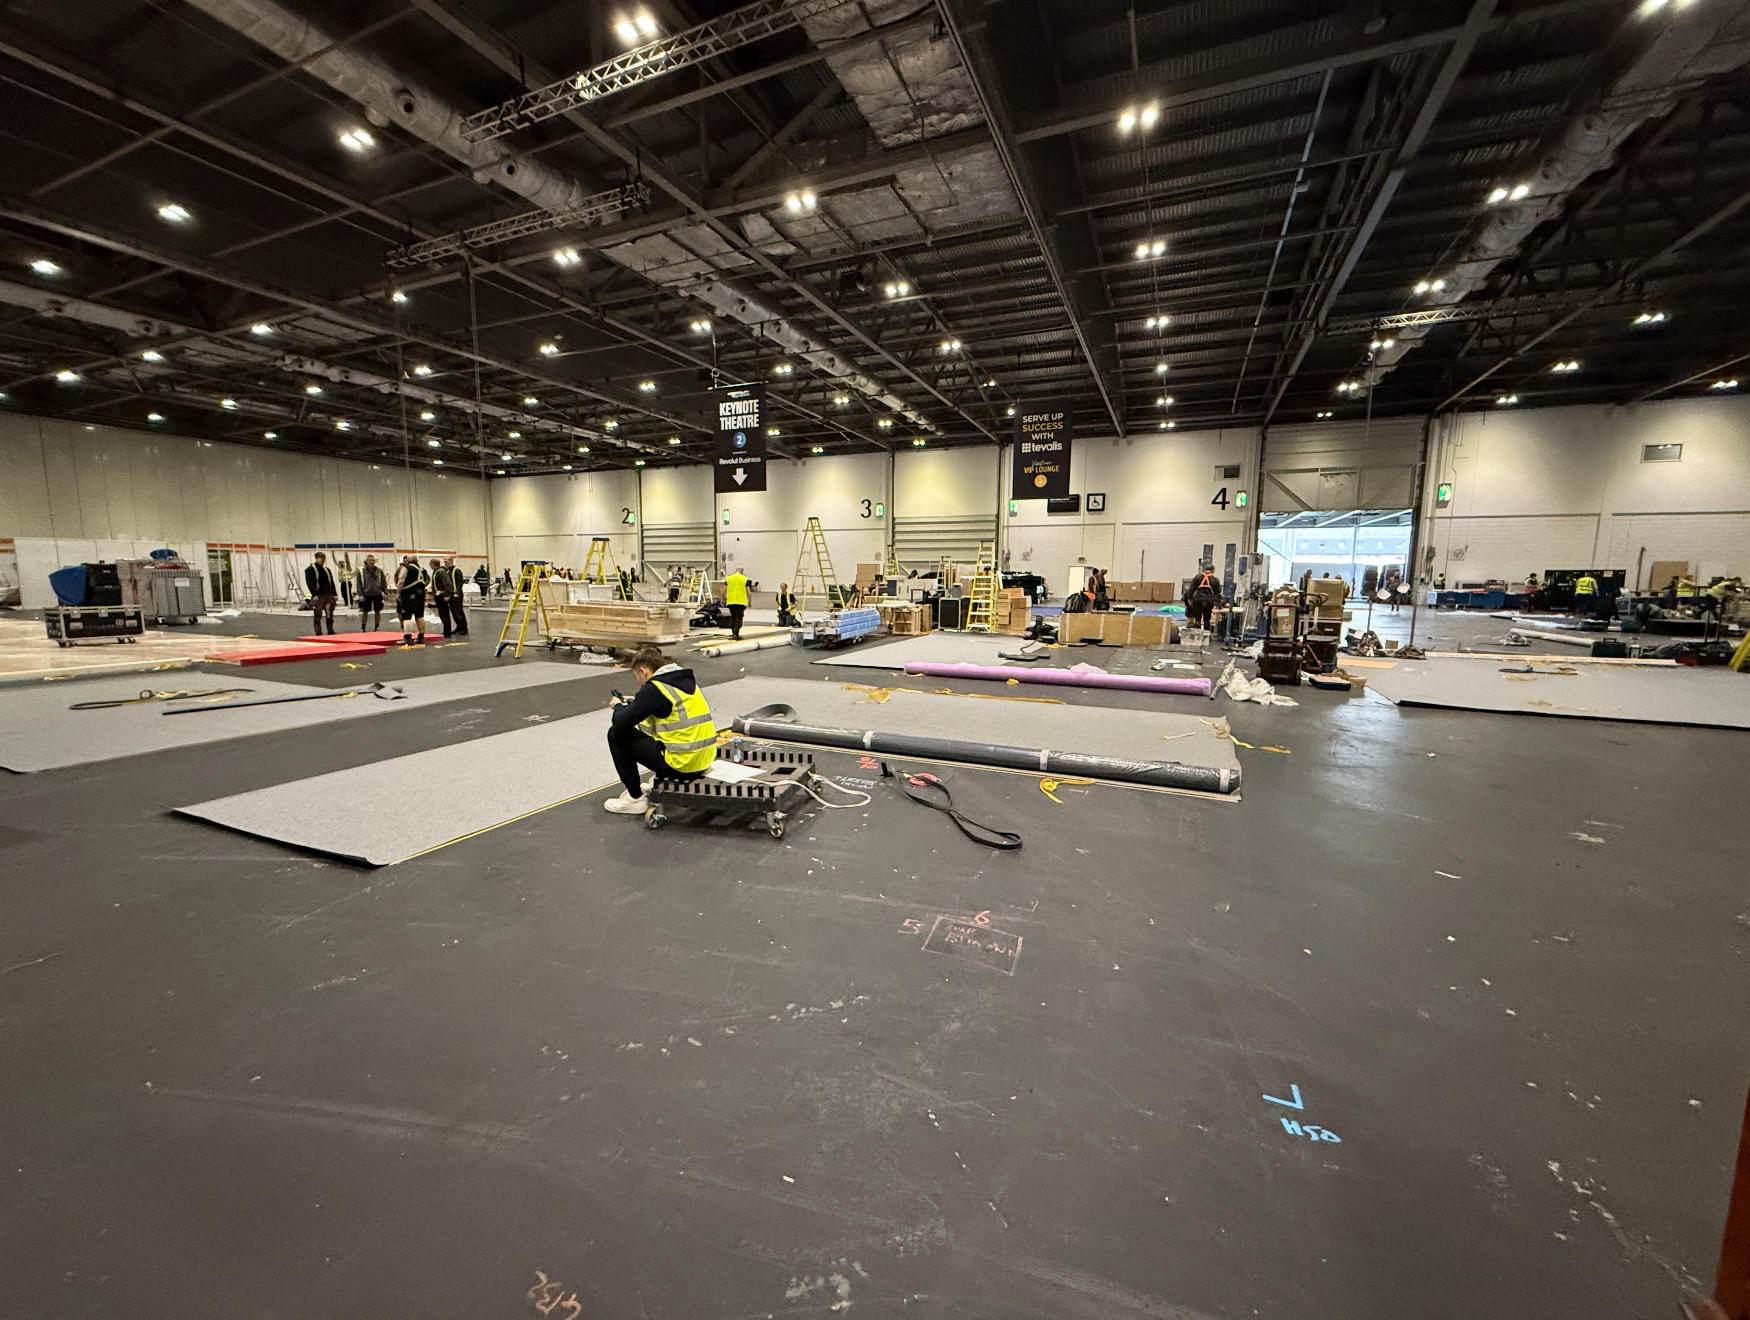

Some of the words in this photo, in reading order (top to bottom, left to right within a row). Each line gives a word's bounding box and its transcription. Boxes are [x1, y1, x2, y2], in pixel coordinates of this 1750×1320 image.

[719, 399, 759, 416] KEYNOTE
[720, 414, 760, 431] THEATRE
[1022, 413, 1049, 423] SERVE
[1051, 412, 1064, 421] UP
[1022, 422, 1064, 432] SUCCESS
[736, 435, 743, 445] 2
[1031, 432, 1054, 440] WITH
[1032, 441, 1063, 452] tevalis
[1023, 466, 1034, 474] VIP
[1035, 465, 1059, 473] LOUNGE
[1211, 487, 1230, 510] 4
[860, 498, 872, 518] 3
[621, 507, 630, 524] 2
